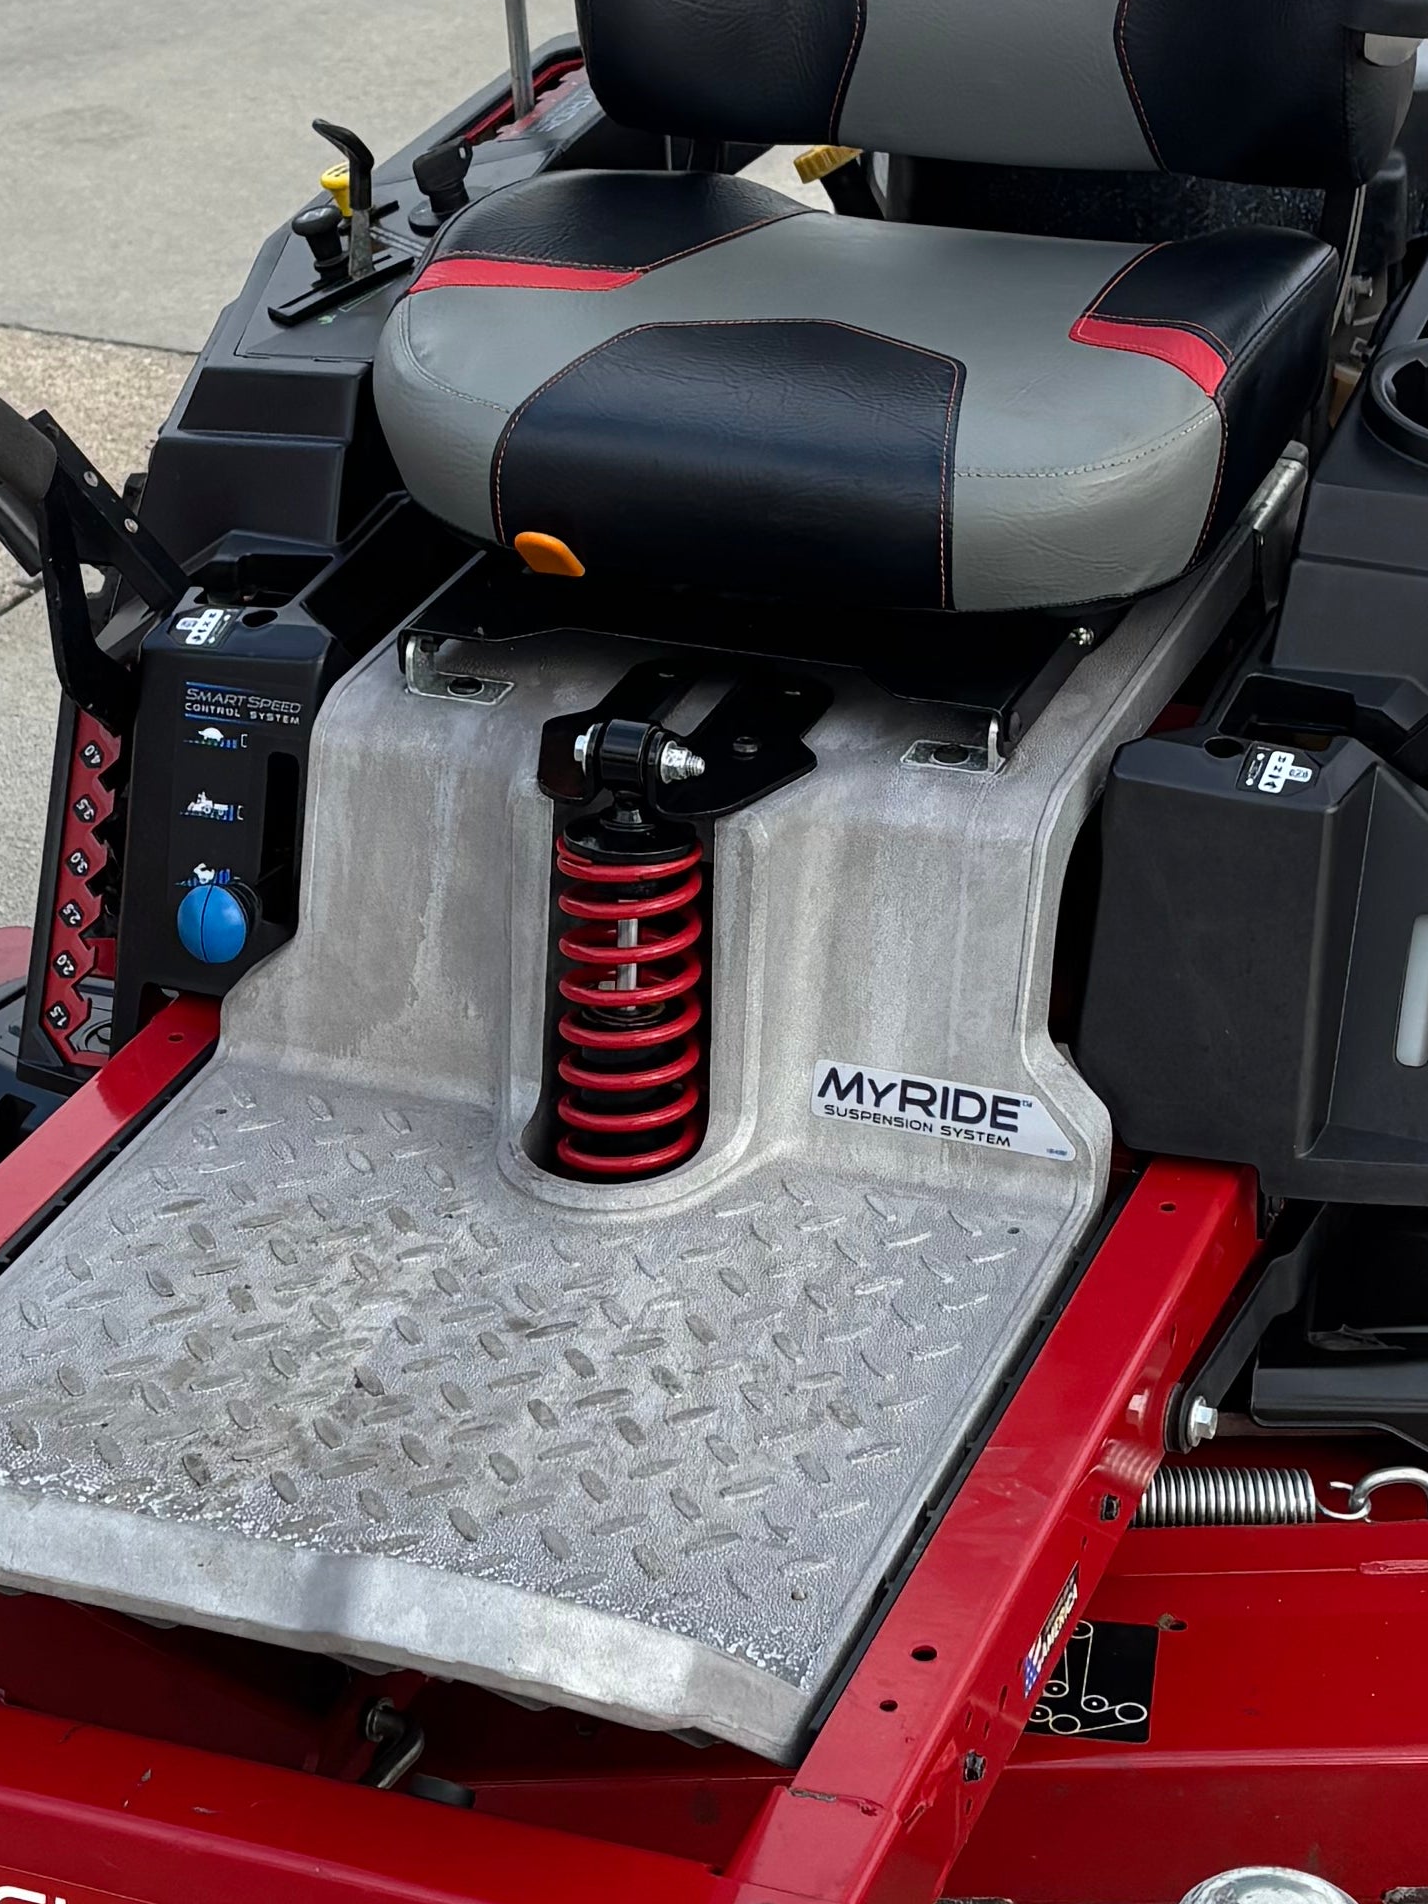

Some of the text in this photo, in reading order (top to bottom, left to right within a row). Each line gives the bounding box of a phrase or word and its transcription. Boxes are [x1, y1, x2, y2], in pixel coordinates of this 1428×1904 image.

[185, 687, 302, 714] SMART SPEED
[184, 702, 301, 725] CONTROL SYSTEM
[84, 744, 101, 764] 4.0
[76, 798, 95, 820] 3.5
[70, 852, 88, 874] 3.0
[62, 903, 81, 925] 2.5
[56, 954, 75, 976] 2.0
[49, 1005, 67, 1027] 1.5
[823, 1104, 1011, 1147] SUSPENSION SYSTEM
